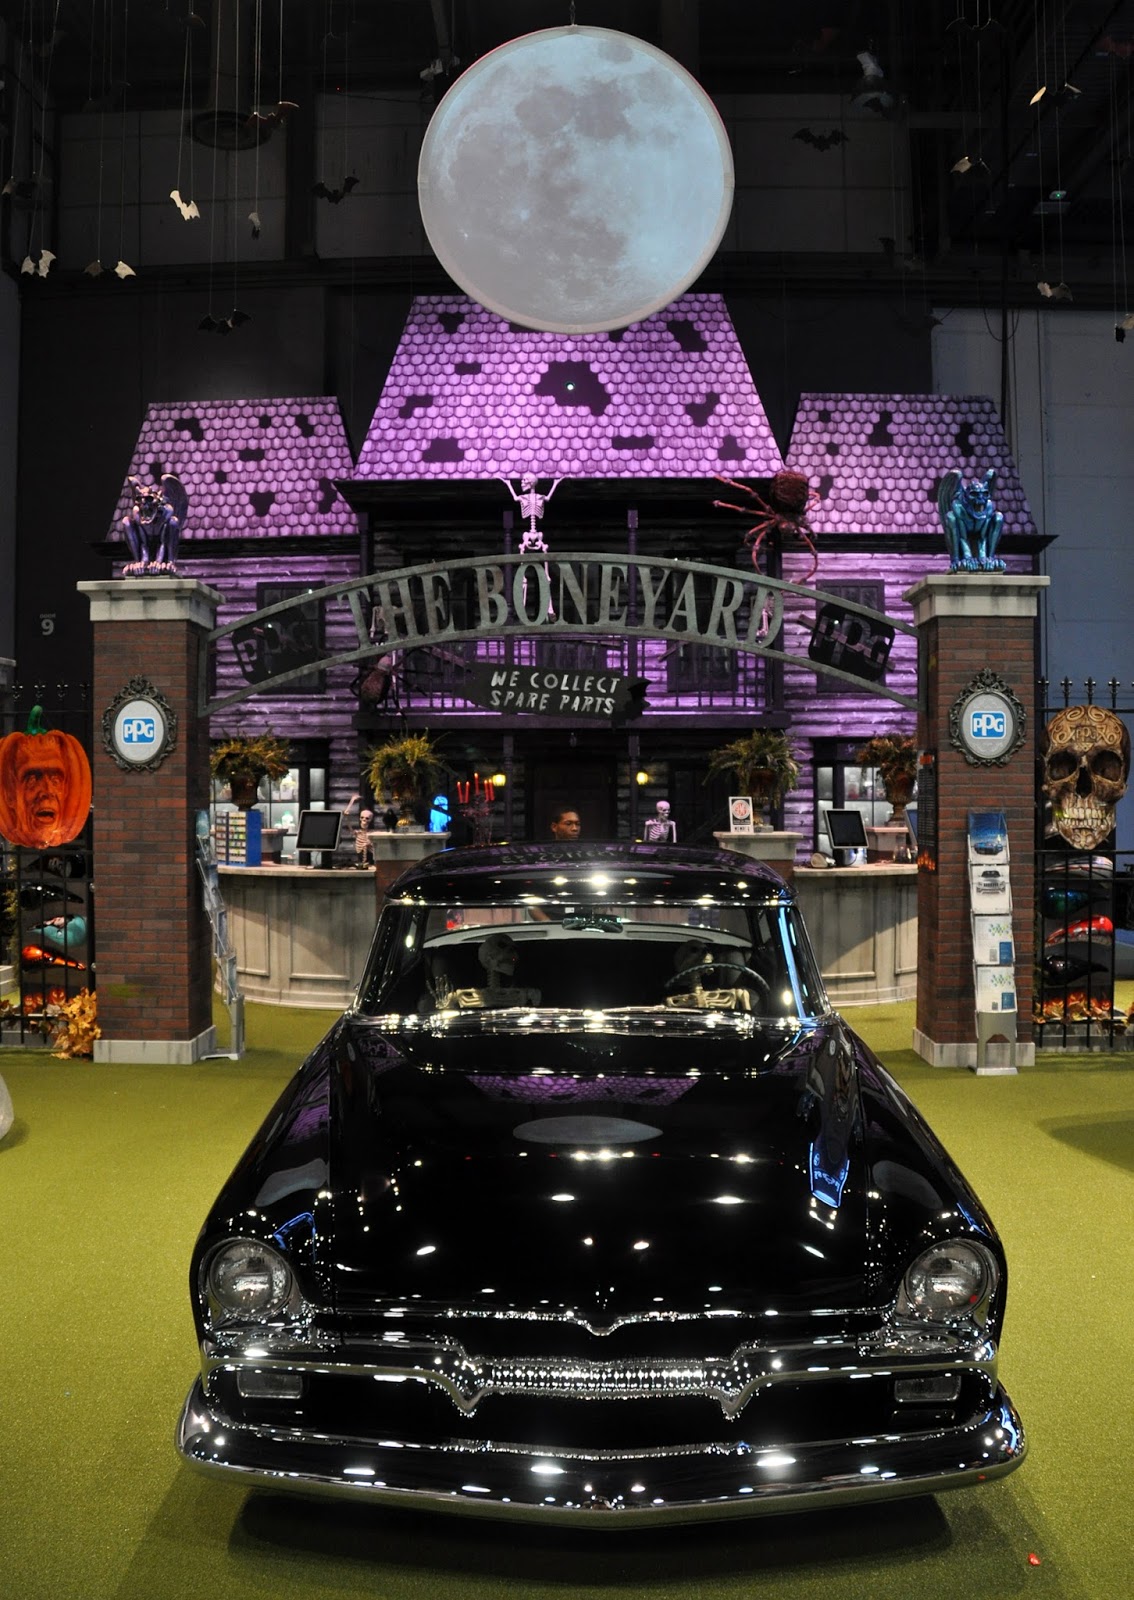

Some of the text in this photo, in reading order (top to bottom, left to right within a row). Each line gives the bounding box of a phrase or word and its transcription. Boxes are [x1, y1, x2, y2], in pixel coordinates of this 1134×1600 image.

[339, 561, 786, 650] THE BONEYARD
[41, 618, 54, 635] 9
[490, 671, 621, 693] WE COLLECT
[490, 690, 616, 714] SPARE PARTS
[123, 719, 155, 742] PPG
[973, 713, 1004, 737] PPG
